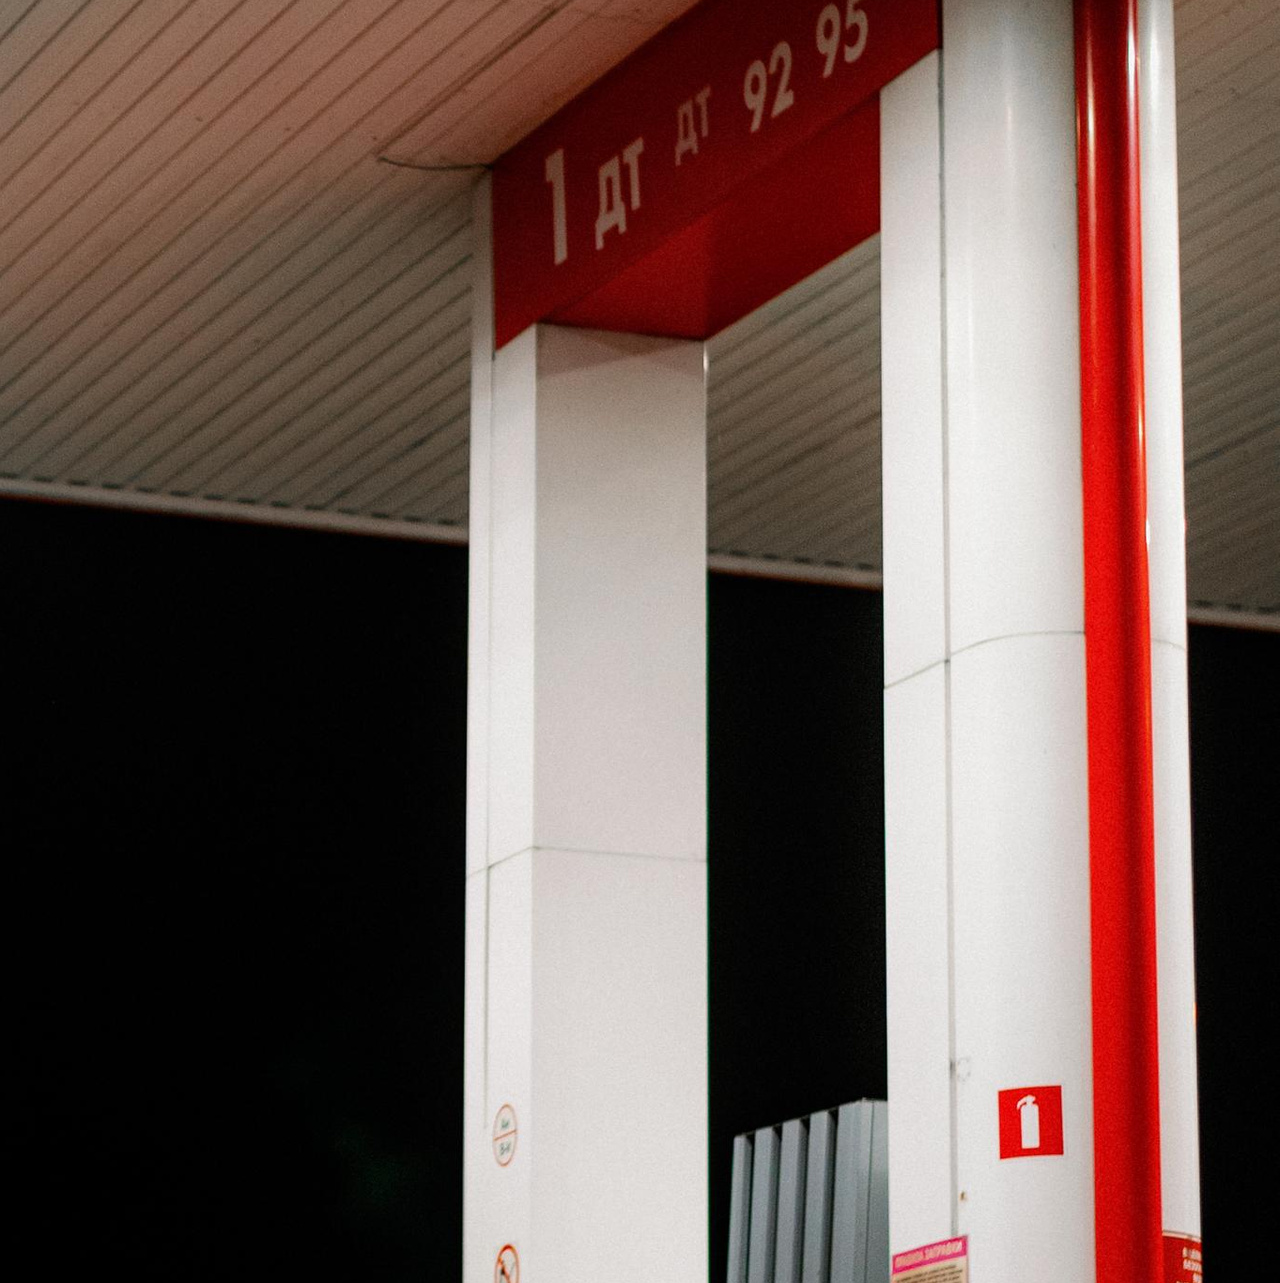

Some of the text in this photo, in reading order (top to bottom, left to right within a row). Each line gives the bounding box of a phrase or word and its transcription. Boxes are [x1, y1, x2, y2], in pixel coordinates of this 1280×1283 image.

[545, 148, 568, 265] 1
[595, 137, 644, 251] ДТ
[675, 85, 711, 166] ДТ
[743, 41, 795, 134] 92
